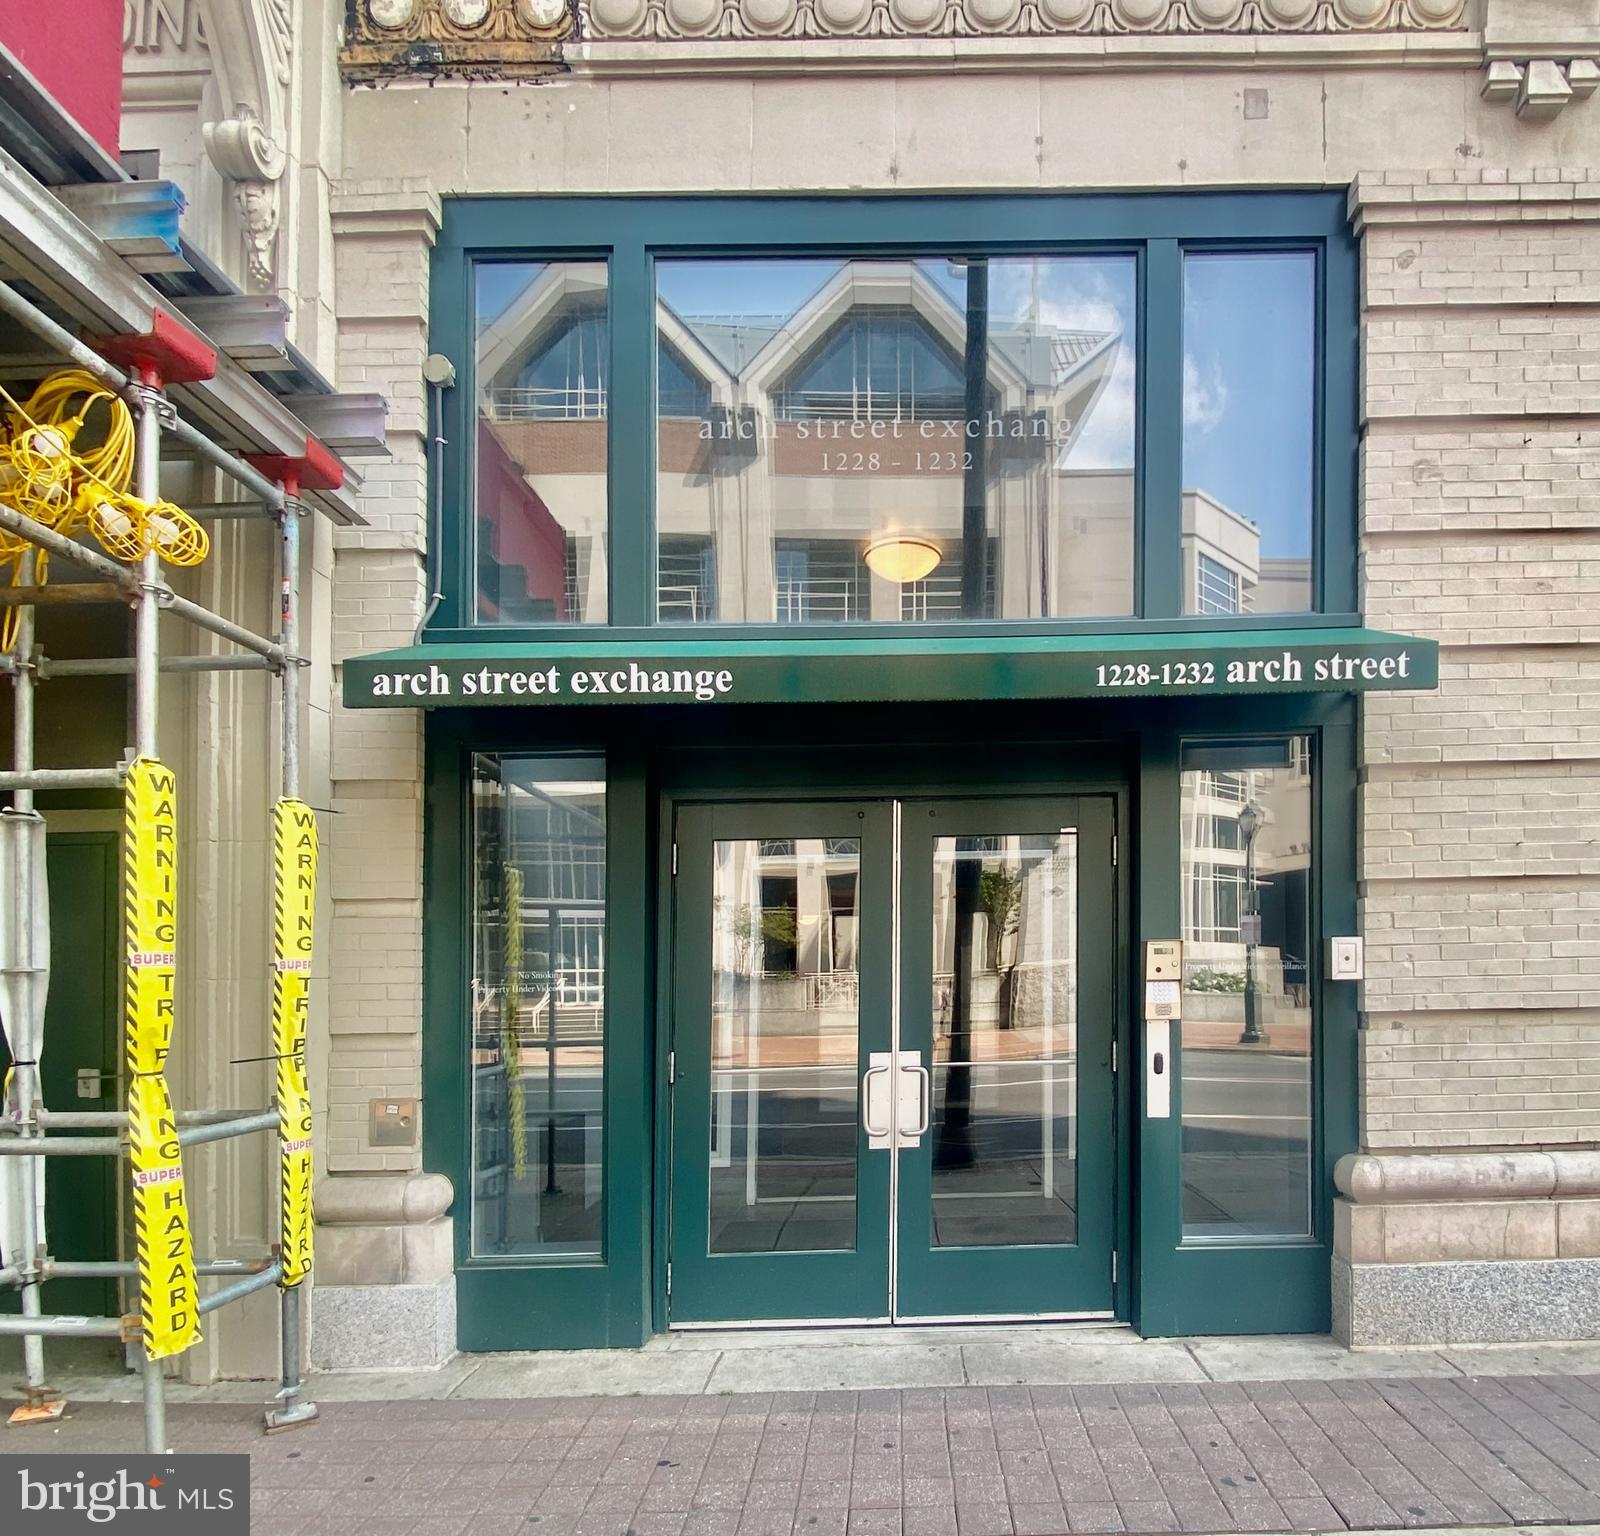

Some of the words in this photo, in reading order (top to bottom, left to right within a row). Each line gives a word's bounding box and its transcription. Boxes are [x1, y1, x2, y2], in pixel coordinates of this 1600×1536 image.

[698, 415, 779, 440] arch
[796, 416, 905, 439] street
[919, 411, 1092, 447] exchang
[821, 452, 882, 472] 1228
[914, 451, 975, 472] 1232
[372, 664, 451, 696] arch
[462, 664, 561, 695] street
[570, 663, 734, 701] exchange
[1096, 662, 1215, 687] 1228-1232
[1226, 652, 1302, 684] arch
[1314, 650, 1410, 681] street
[150, 773, 175, 943] WARNING
[293, 811, 314, 952] WARNING
[518, 971, 530, 980] No
[531, 971, 563, 981] Smokin
[139, 1168, 182, 1184] SUPER
[299, 1158, 313, 1274] HAZARD
[163, 1190, 188, 1333] HAZARD
